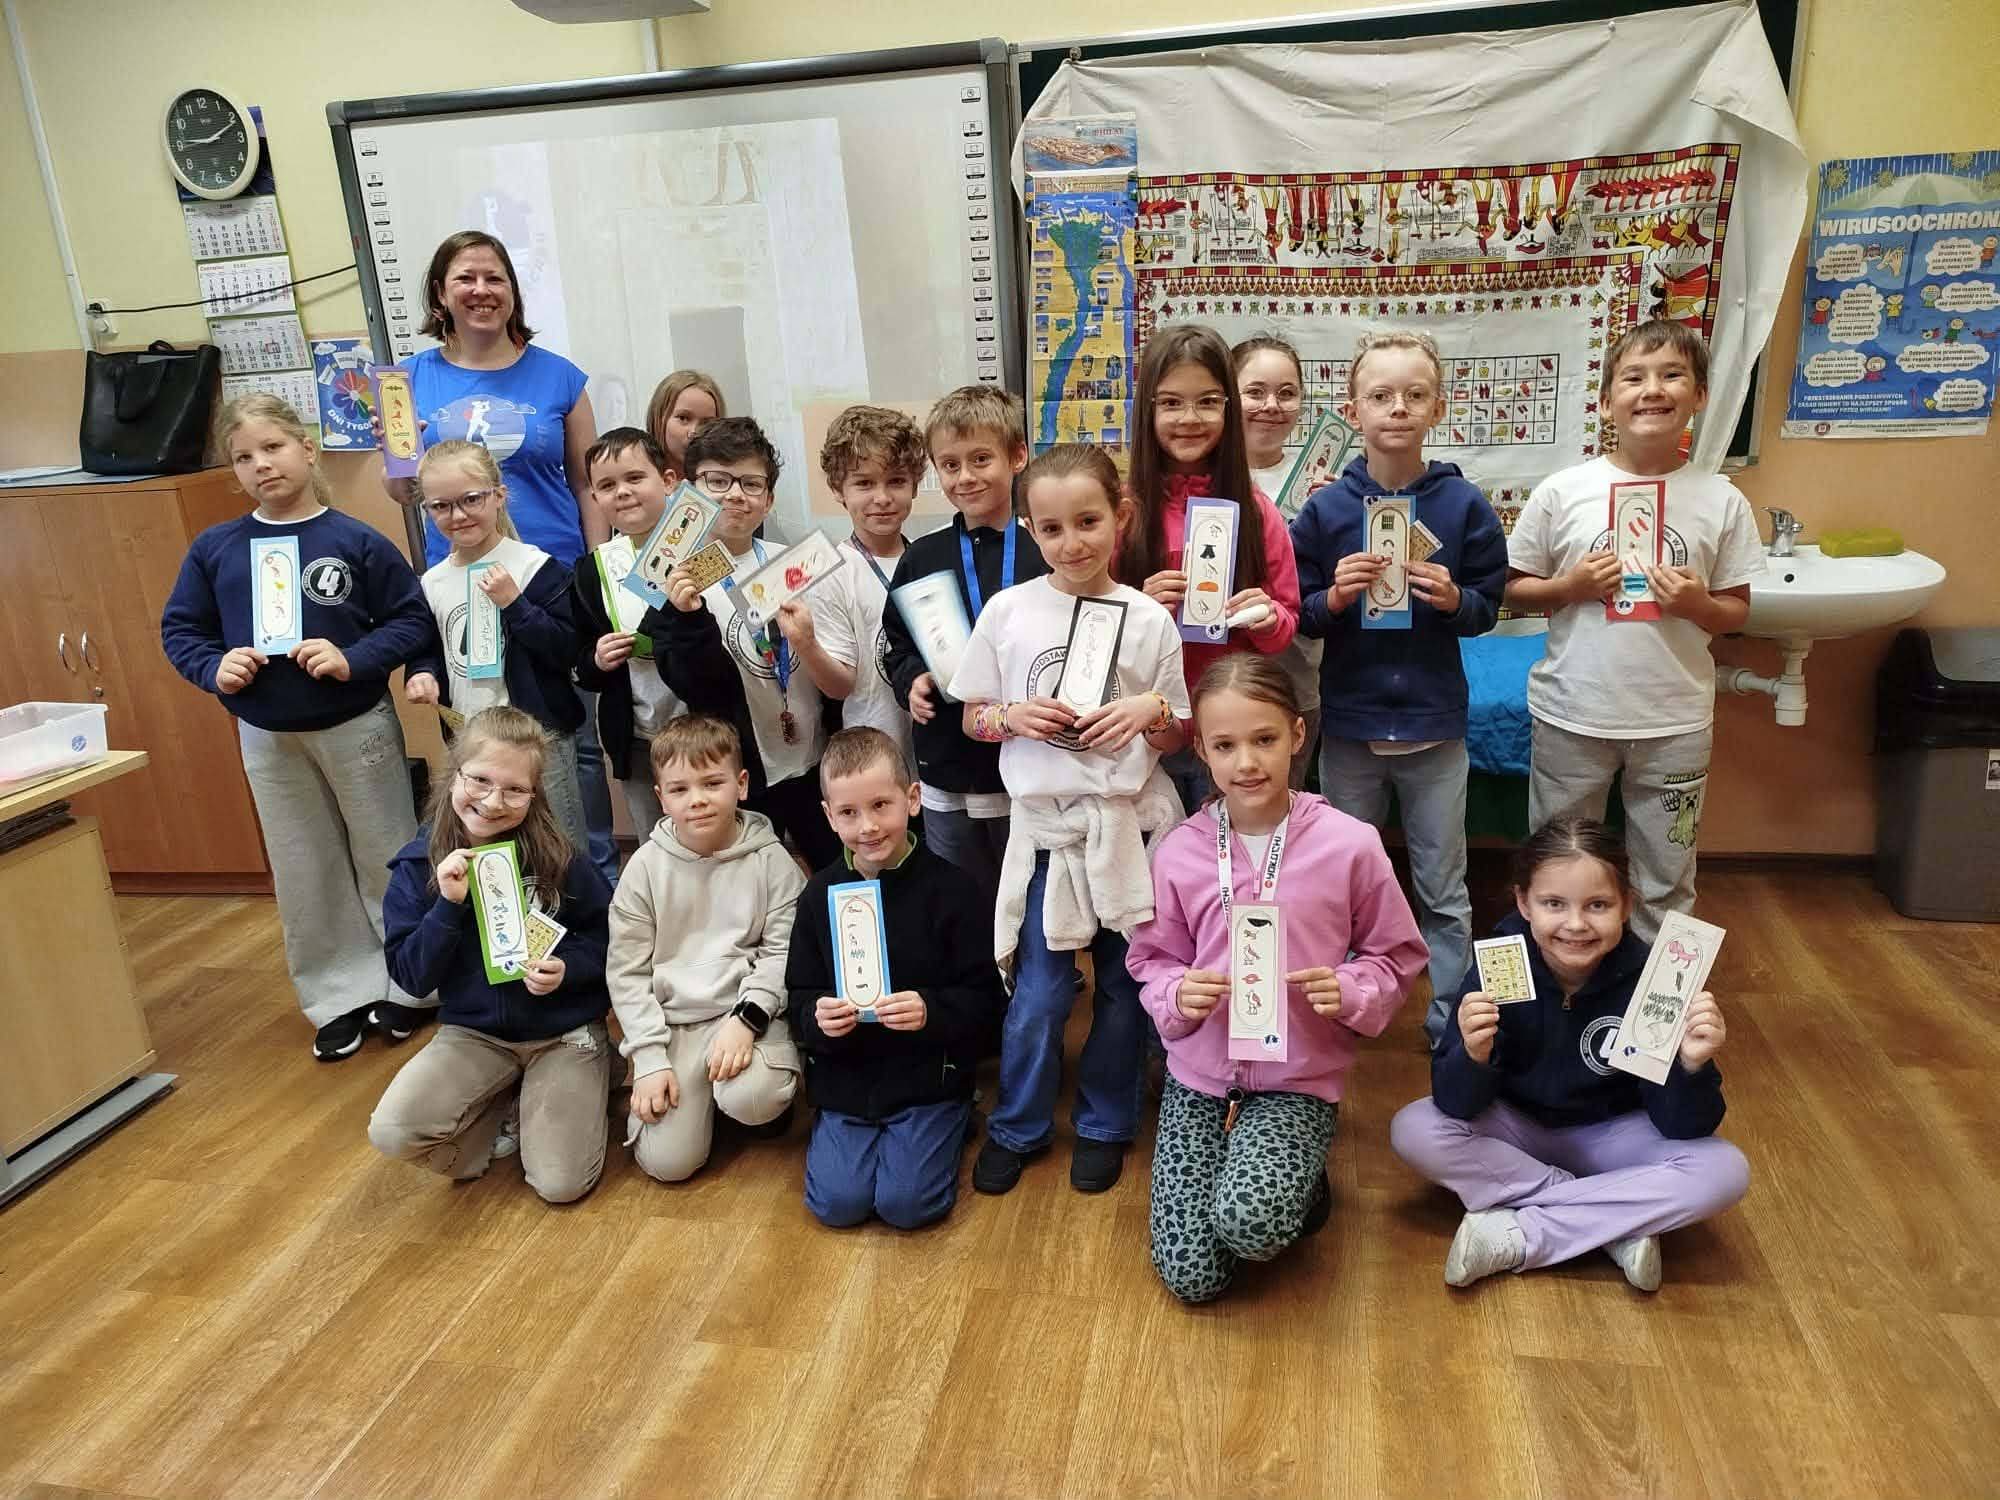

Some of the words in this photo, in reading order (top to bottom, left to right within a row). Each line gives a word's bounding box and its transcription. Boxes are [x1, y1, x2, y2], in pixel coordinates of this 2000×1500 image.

[196, 97, 207, 108] 12
[215, 100, 220, 111] 1
[185, 104, 193, 115] 11
[228, 111, 236, 122] 2
[176, 118, 186, 130] 10
[237, 131, 245, 143] 3
[176, 141, 183, 151] 9
[237, 152, 244, 162] 4
[186, 158, 193, 169] 8
[199, 170, 205, 181] 7
[229, 166, 237, 177] 5
[215, 173, 223, 184] 6
[328, 409, 345, 426] DNI
[317, 565, 341, 596] 4
